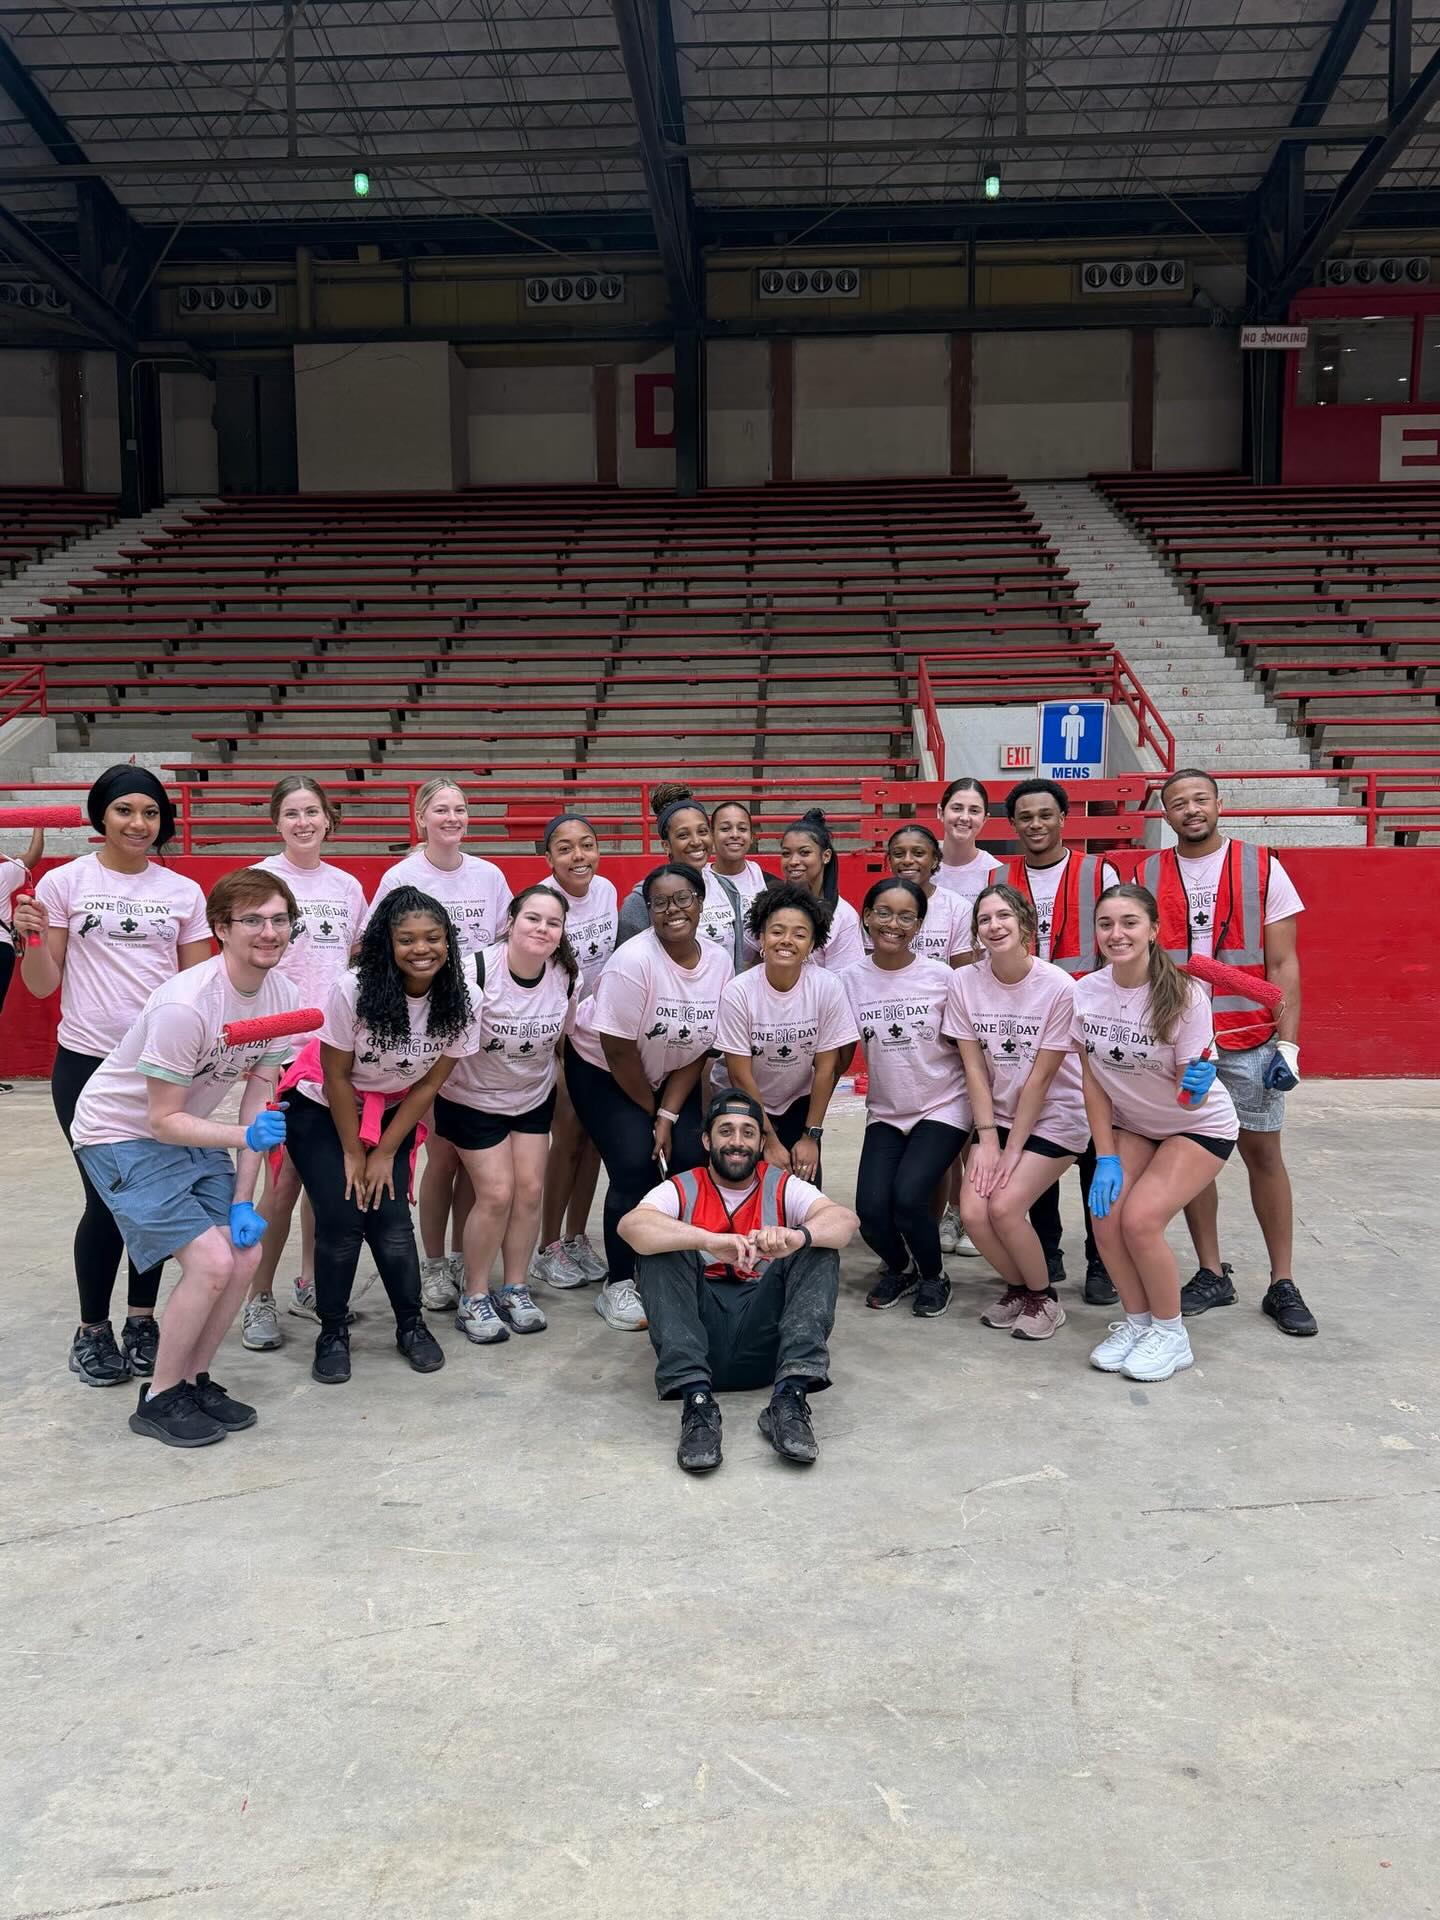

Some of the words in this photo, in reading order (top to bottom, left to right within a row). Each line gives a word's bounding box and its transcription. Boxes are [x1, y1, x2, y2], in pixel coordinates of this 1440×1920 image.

[1243, 332, 1257, 343] NO
[1261, 332, 1307, 343] SMOKING
[1380, 414, 1440, 481] E
[1105, 563, 1114, 571] 12
[1126, 601, 1136, 609] 10
[1167, 663, 1172, 672] 7
[1182, 687, 1188, 697] 6
[1197, 713, 1204, 722] 5
[1215, 744, 1222, 754] 4
[1007, 747, 1032, 766] EXIT
[1052, 767, 1090, 779] MENS
[1190, 891, 1212, 909] BIG
[84, 902, 115, 911] ONE
[117, 901, 143, 916] BIG
[144, 905, 171, 915] DAY
[311, 904, 335, 919] BIG
[333, 907, 349, 918] DAY
[465, 908, 485, 918] DAY
[715, 911, 732, 919] DAY
[583, 923, 600, 941] BIG
[598, 921, 613, 933] DAY
[925, 939, 948, 947] DAY
[656, 1006, 678, 1018] ONE
[696, 1010, 716, 1020] DAY
[860, 1010, 882, 1021] ONE
[883, 1003, 906, 1021] BIG
[906, 1005, 930, 1016] DAY
[491, 1024, 518, 1036] ONE
[519, 1022, 540, 1038] BIG
[541, 1022, 560, 1034] DAY
[973, 1023, 997, 1033] ONE
[1016, 1025, 1040, 1035] DAY
[1083, 1022, 1108, 1037] ONE
[1109, 1024, 1131, 1046] BIG
[1131, 1032, 1157, 1046] DAY
[751, 1031, 774, 1042] ONE
[775, 1028, 797, 1044] BIG
[797, 1027, 817, 1039] DAY
